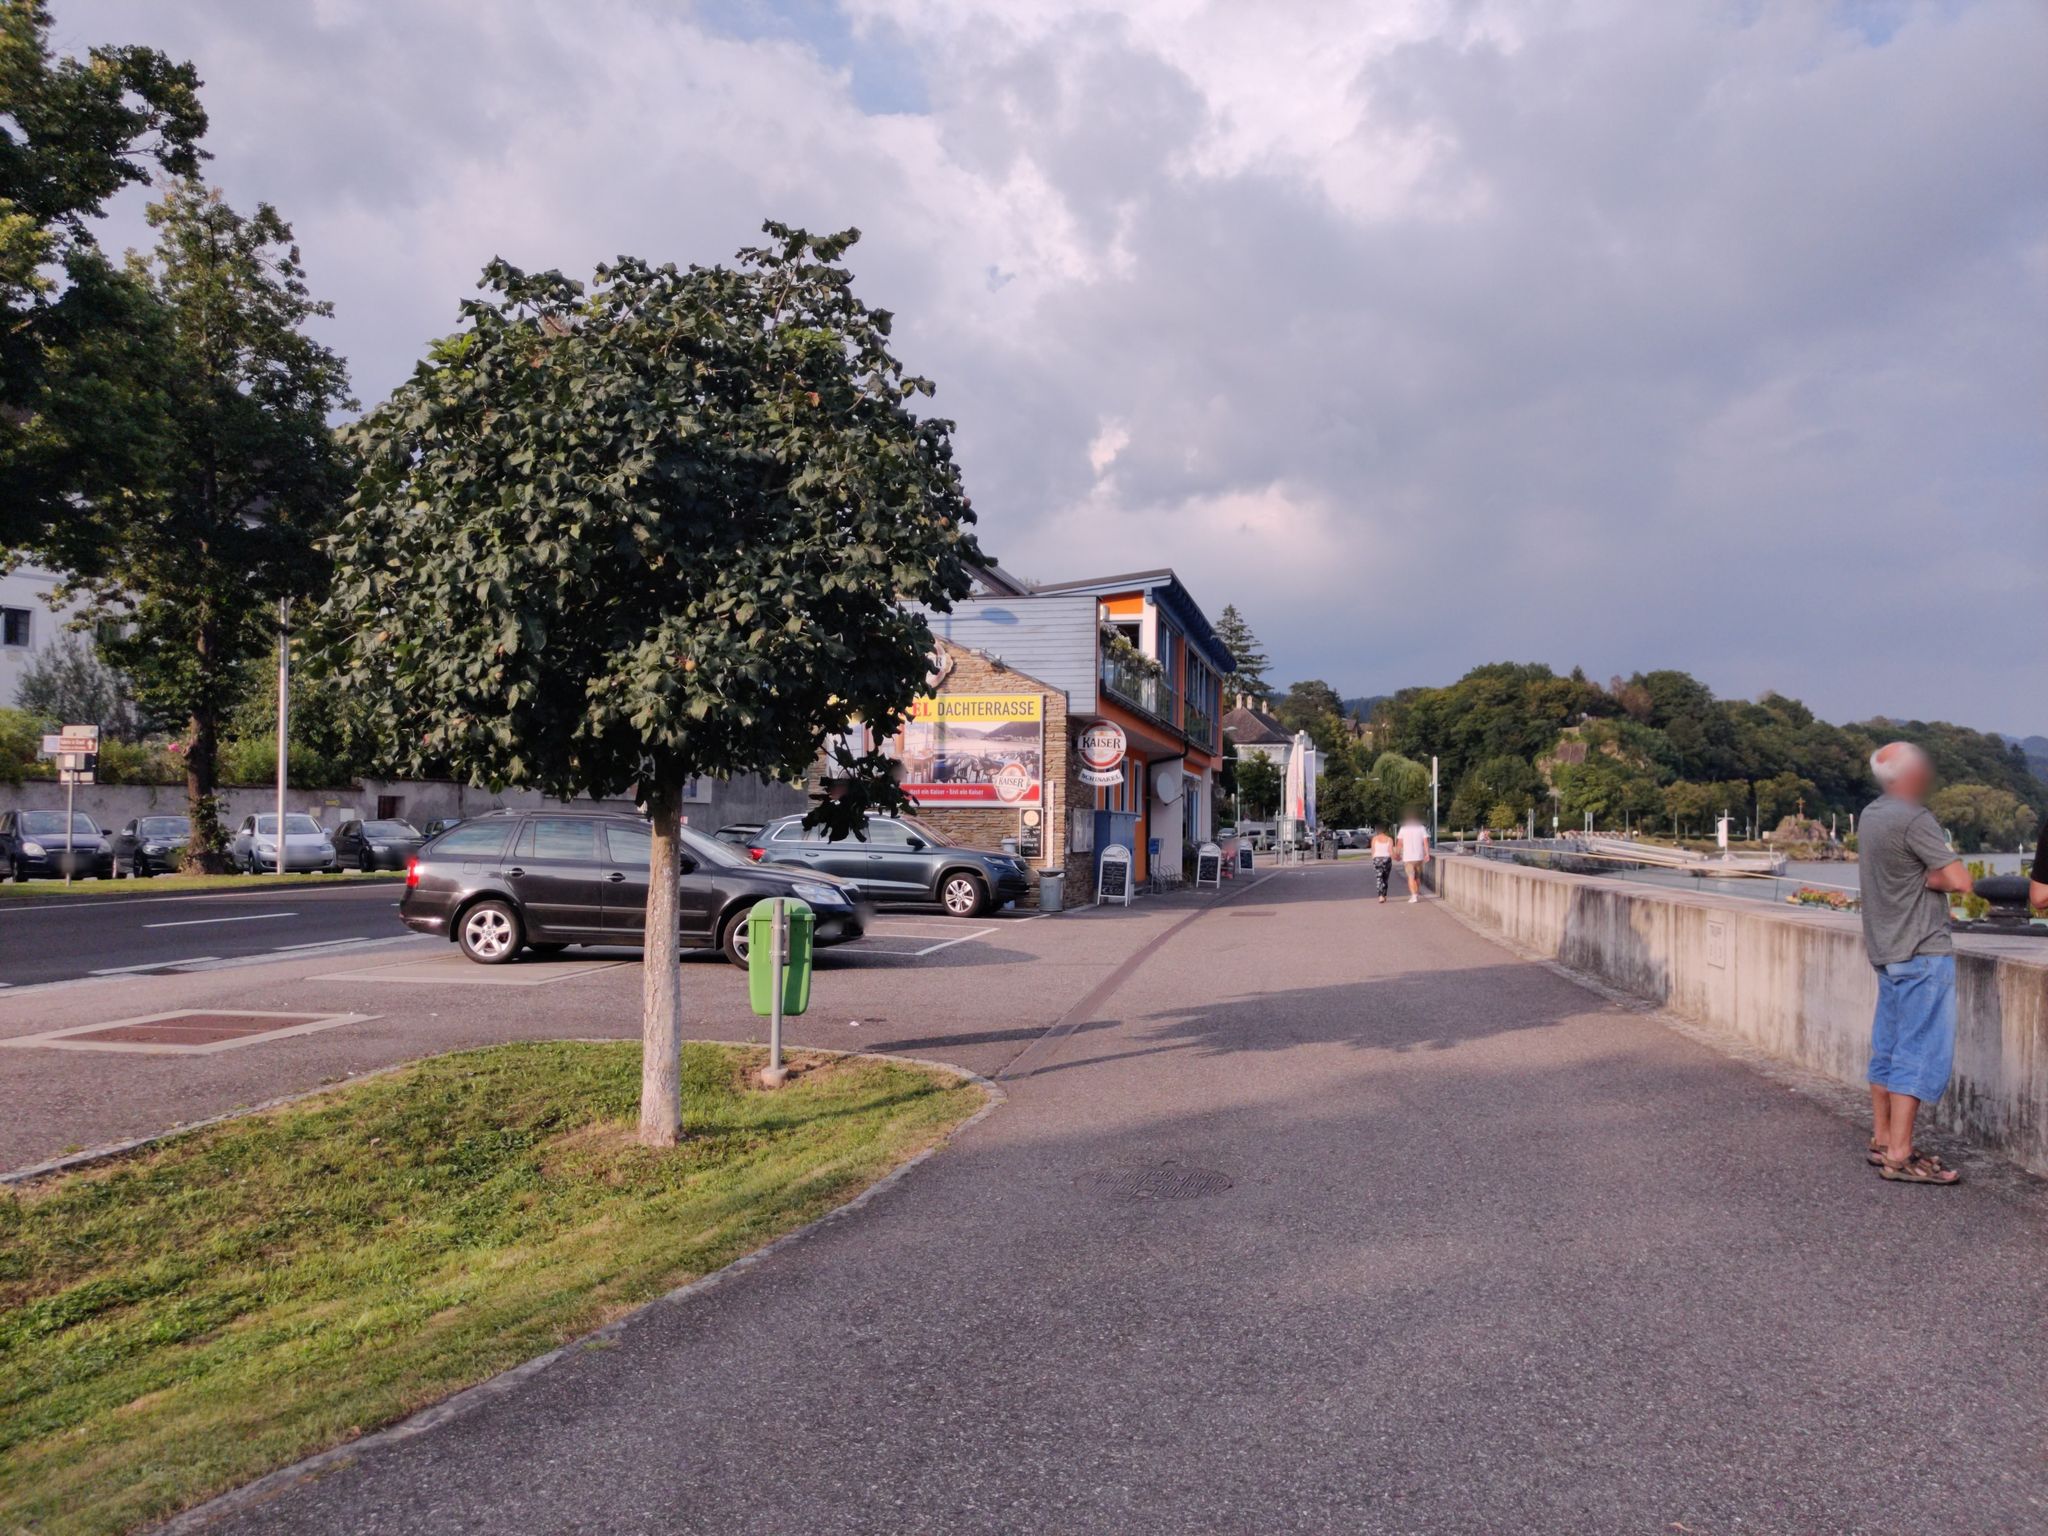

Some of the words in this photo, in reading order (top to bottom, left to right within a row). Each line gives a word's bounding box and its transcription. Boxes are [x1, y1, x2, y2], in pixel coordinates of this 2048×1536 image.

[938, 701, 1034, 716] DACHTERRASSE
[1083, 737, 1120, 748] KAISER
[999, 777, 1024, 787] KAISER
